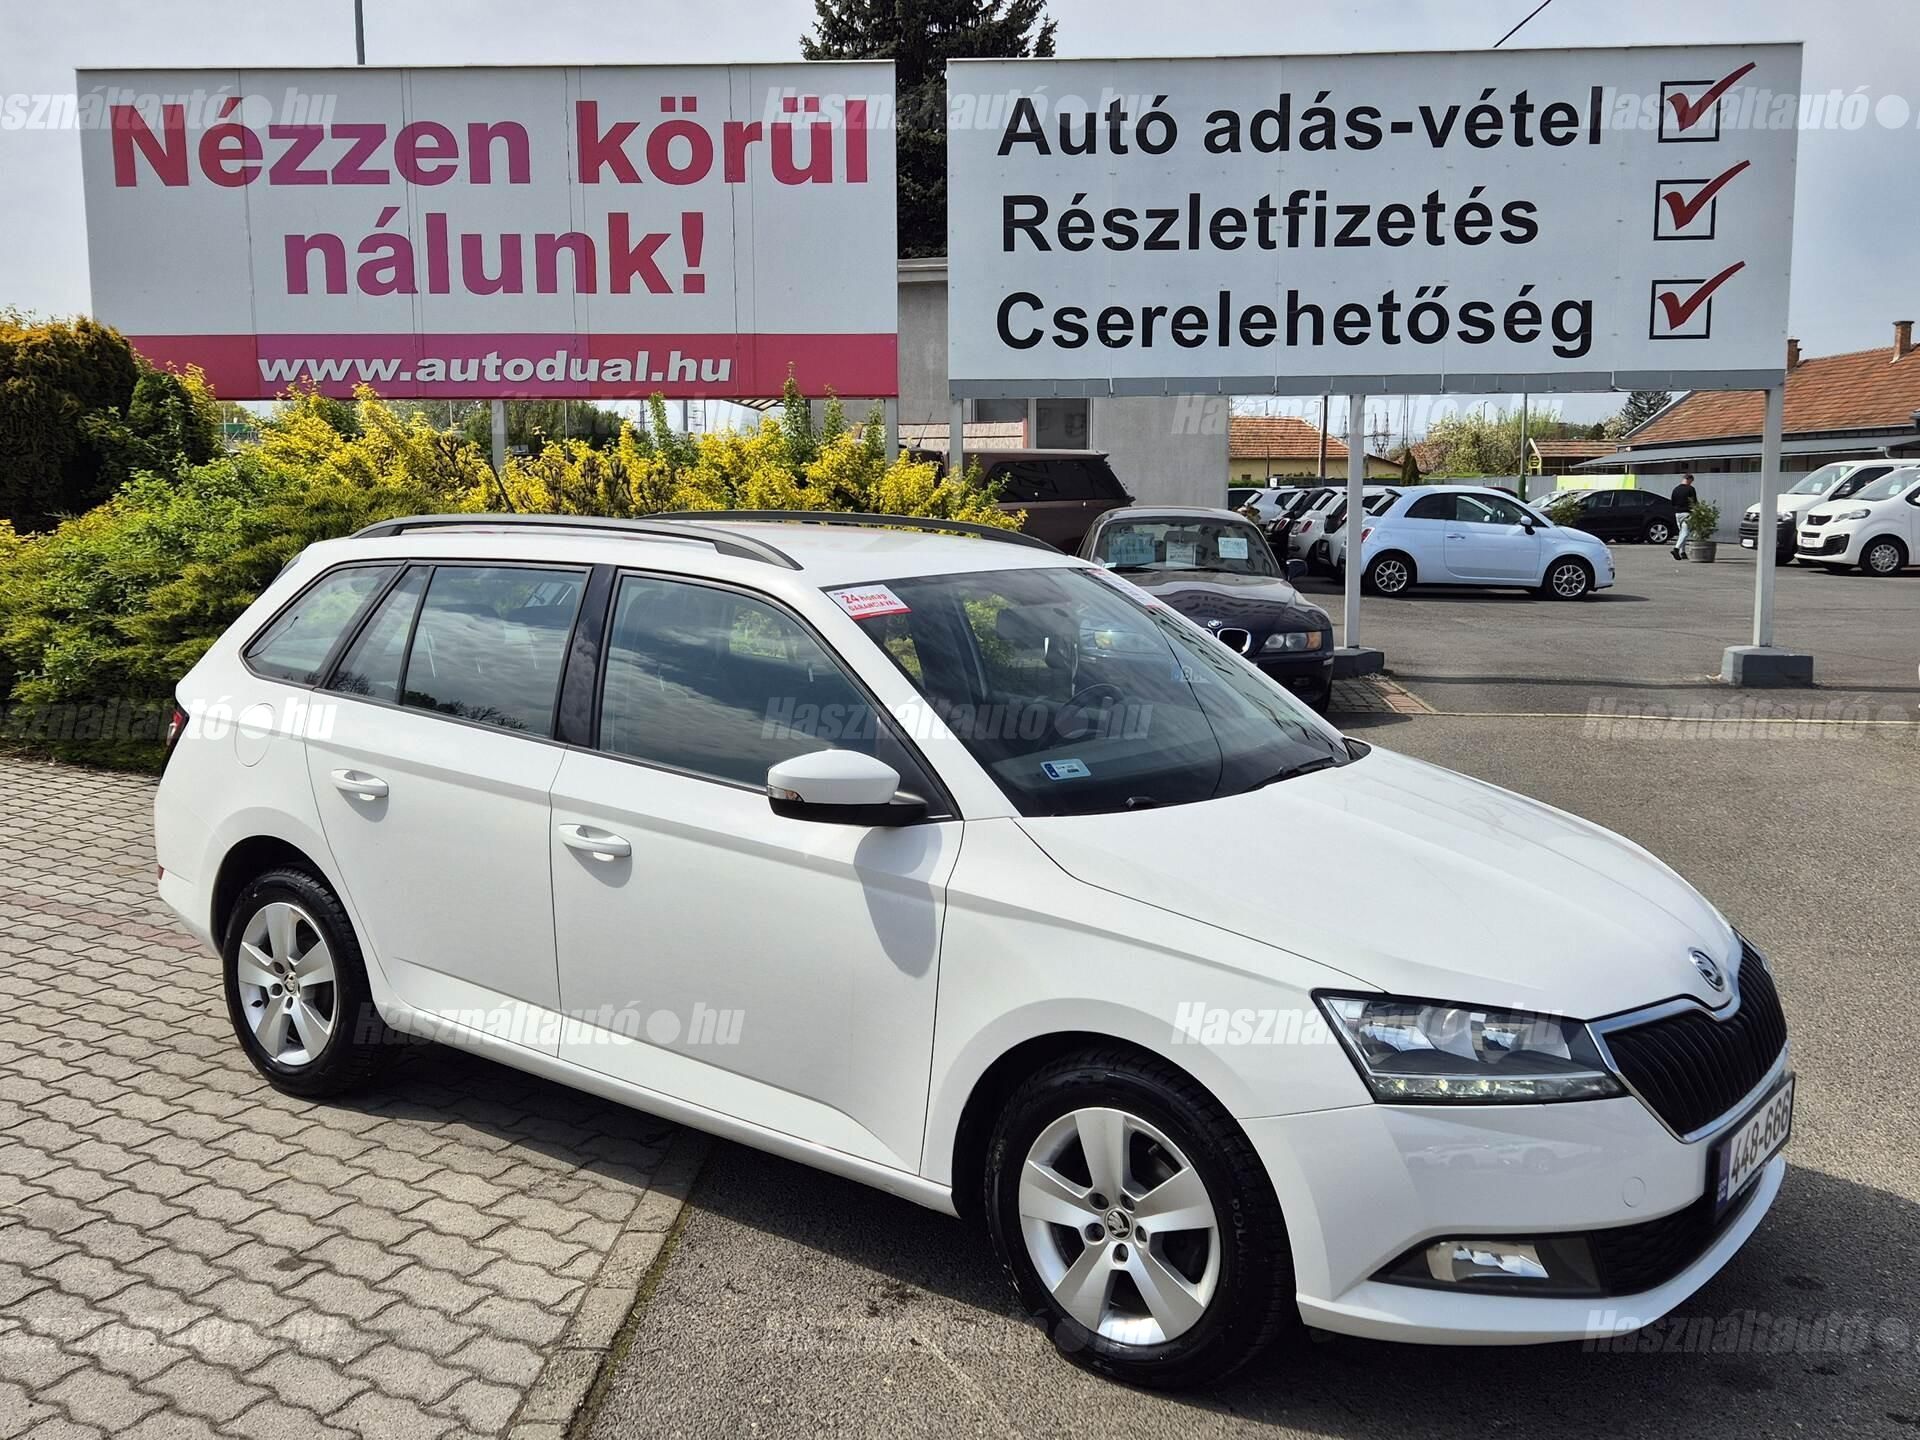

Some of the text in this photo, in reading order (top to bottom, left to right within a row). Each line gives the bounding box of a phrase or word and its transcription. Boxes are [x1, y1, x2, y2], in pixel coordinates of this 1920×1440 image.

[112, 96, 868, 187] Nézzen körül
[997, 86, 1603, 156] Autó adás-vétel
[284, 206, 706, 296] nálunk!
[1003, 186, 1539, 252] Részletfizetés
[996, 284, 1593, 359] Cserelehetőség
[257, 350, 732, 382] www.autodual.hu
[1731, 1089, 1790, 1183] 448-666
